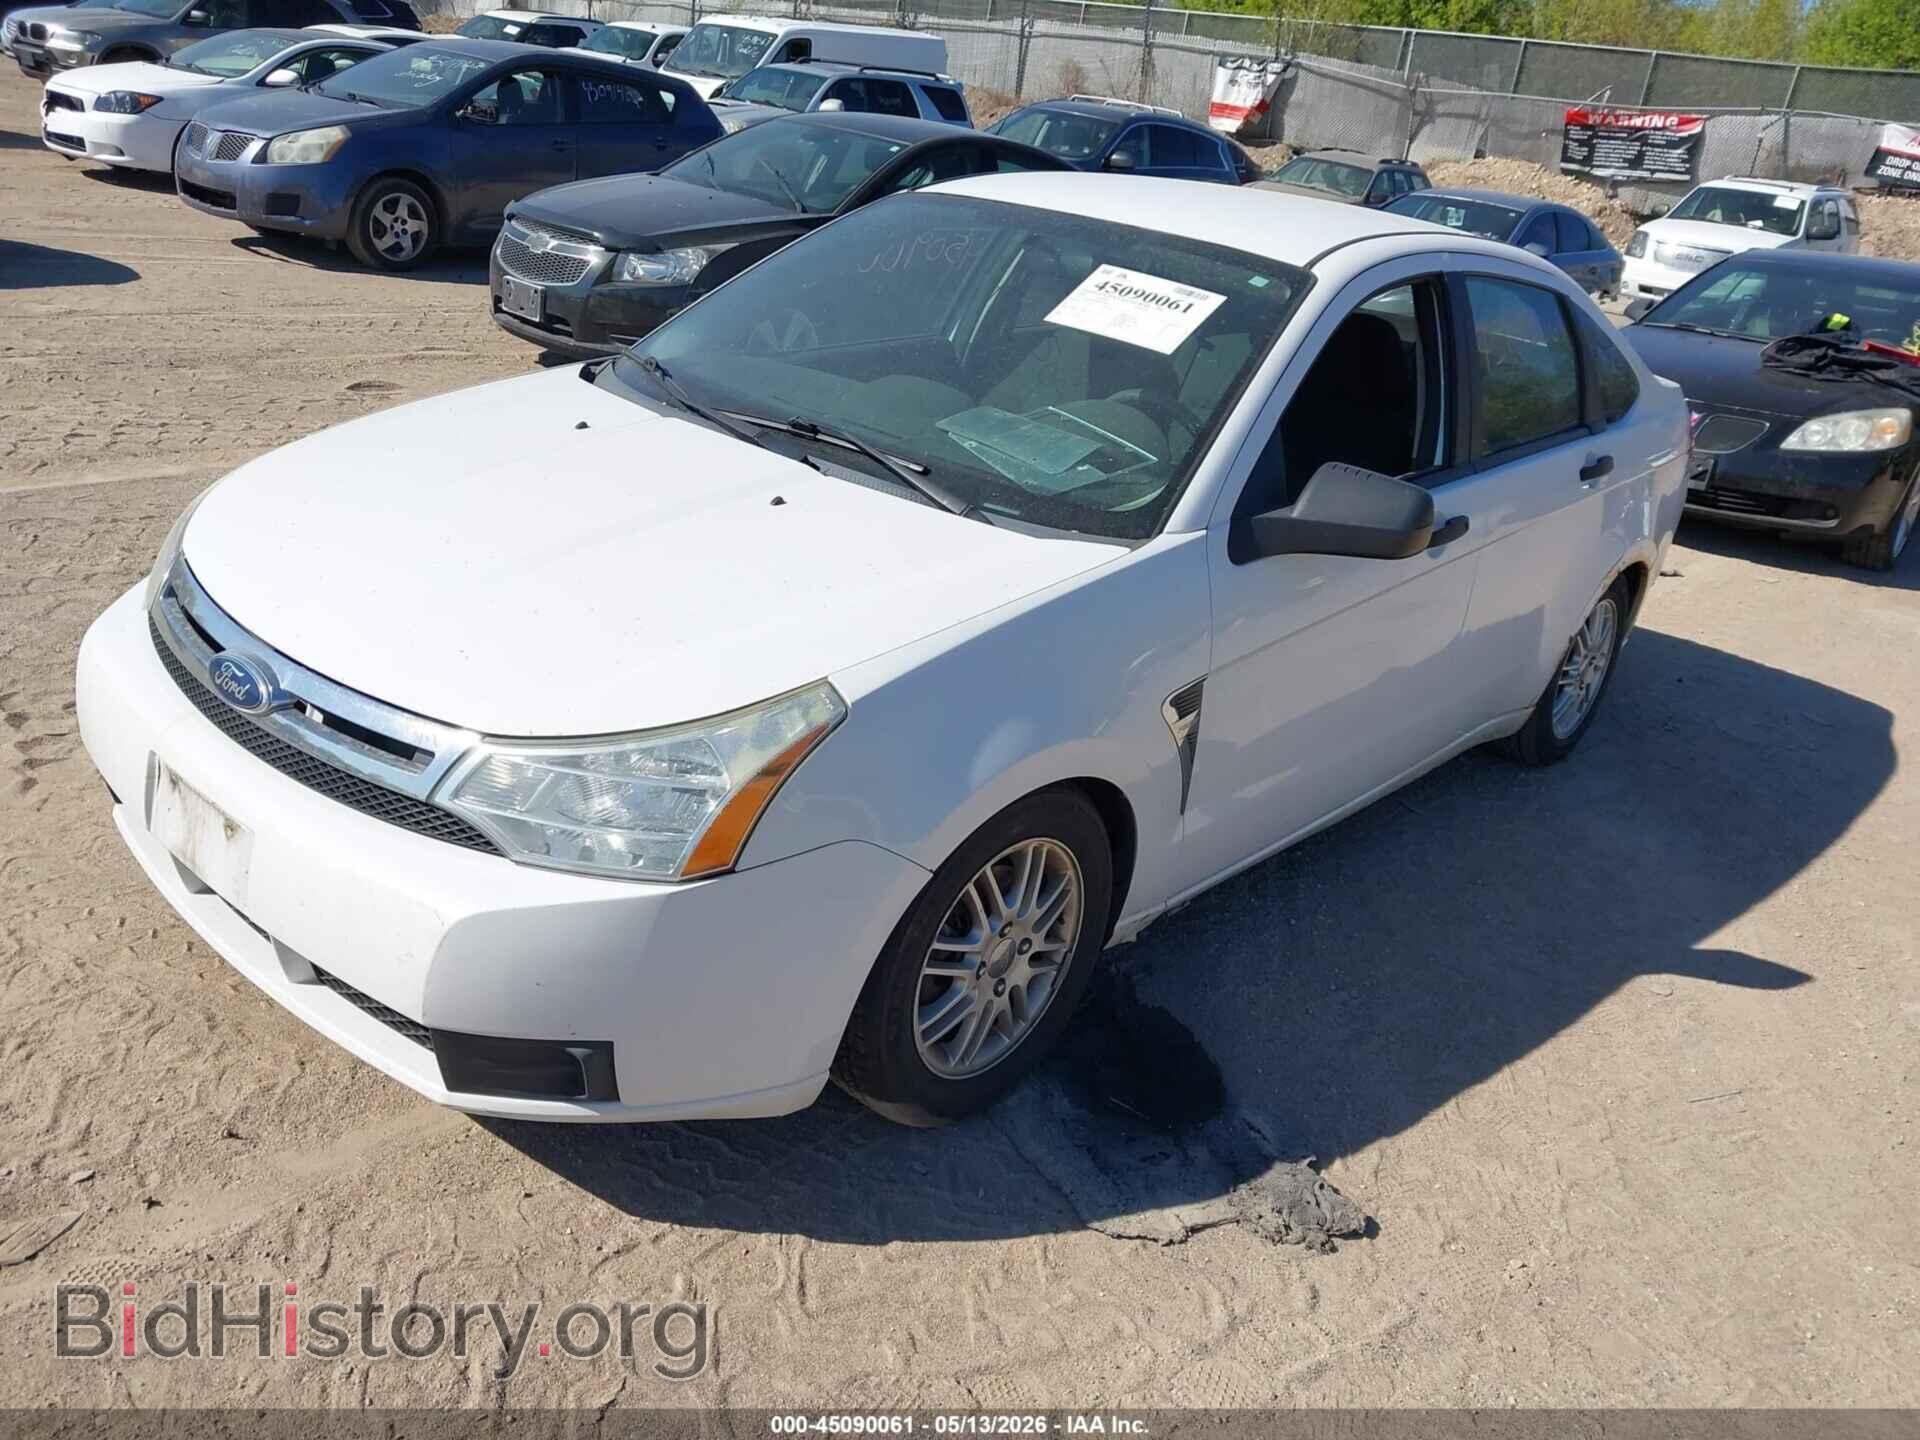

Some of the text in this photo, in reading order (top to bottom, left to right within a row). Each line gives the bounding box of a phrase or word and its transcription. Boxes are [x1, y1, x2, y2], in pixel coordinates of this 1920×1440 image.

[1588, 113, 1679, 129] WARNING
[1886, 156, 1911, 169] DROP
[1877, 165, 1904, 178] ZONE
[1095, 280, 1195, 314] 45090061
[215, 662, 250, 700] Ford
